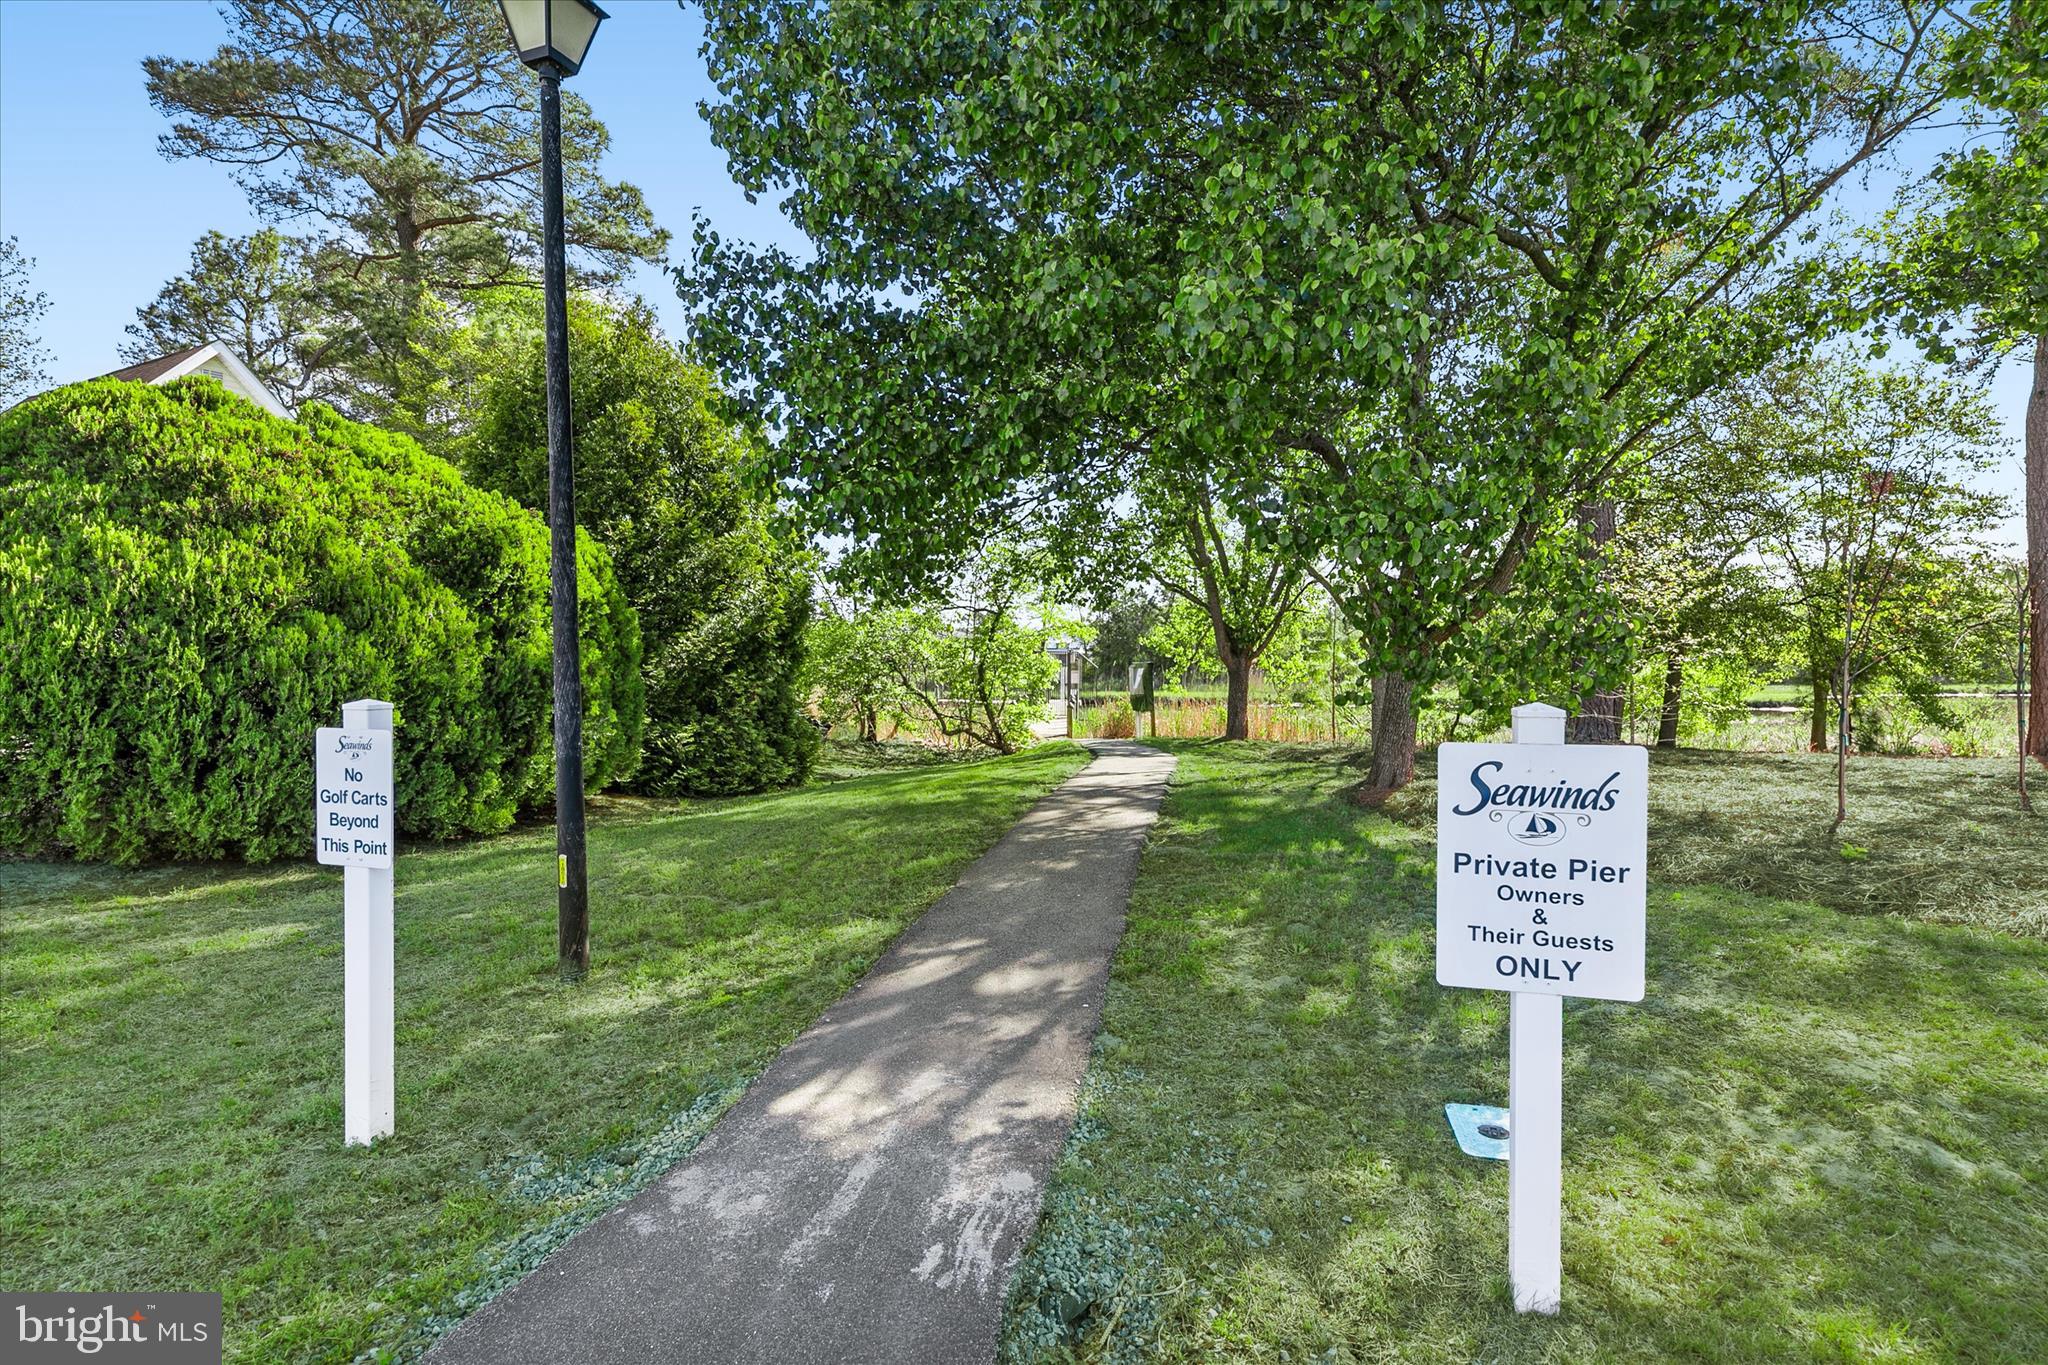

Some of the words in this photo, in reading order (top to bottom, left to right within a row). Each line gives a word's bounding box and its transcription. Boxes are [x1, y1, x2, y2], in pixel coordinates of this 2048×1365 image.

[335, 736, 372, 753] Seawinds
[345, 768, 362, 782] No
[1452, 761, 1620, 816] Seawinds
[321, 789, 348, 804] Golf
[352, 791, 387, 806] Carts
[330, 813, 378, 830] Beyond
[322, 838, 349, 853] This
[354, 840, 387, 855] Point
[1454, 852, 1557, 879] Private
[1570, 859, 1630, 883] Pier
[1497, 885, 1584, 906] Owners
[1532, 909, 1548, 924] &
[1468, 925, 1525, 944] Their
[1532, 930, 1614, 952] Guests
[1496, 956, 1582, 982] ONLY
